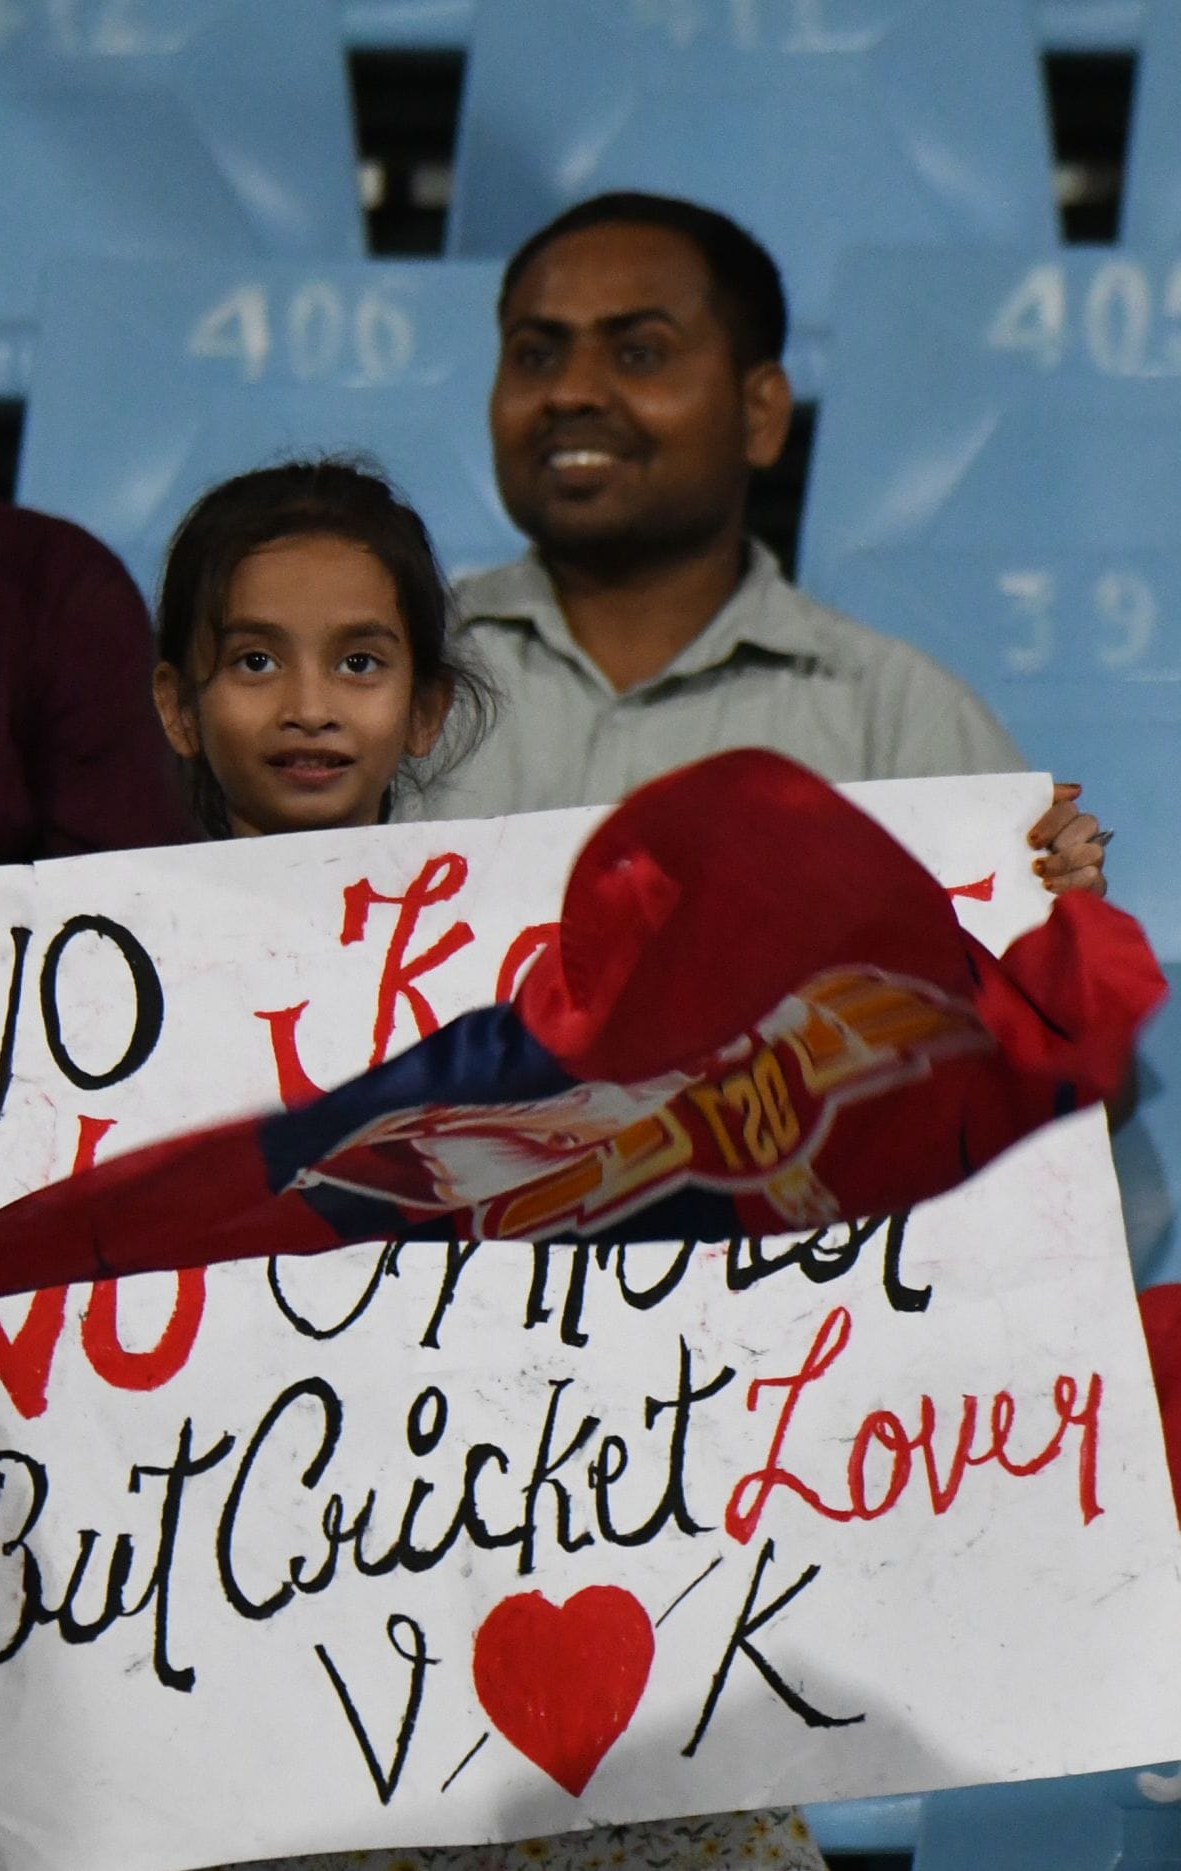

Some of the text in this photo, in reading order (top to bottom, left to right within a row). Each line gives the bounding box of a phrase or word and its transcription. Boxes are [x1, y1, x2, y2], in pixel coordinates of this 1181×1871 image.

[186, 276, 416, 382] 406
[217, 1334, 736, 1621] Cricket
[724, 1305, 1106, 1546] Lover
[314, 1537, 866, 1806] V K
